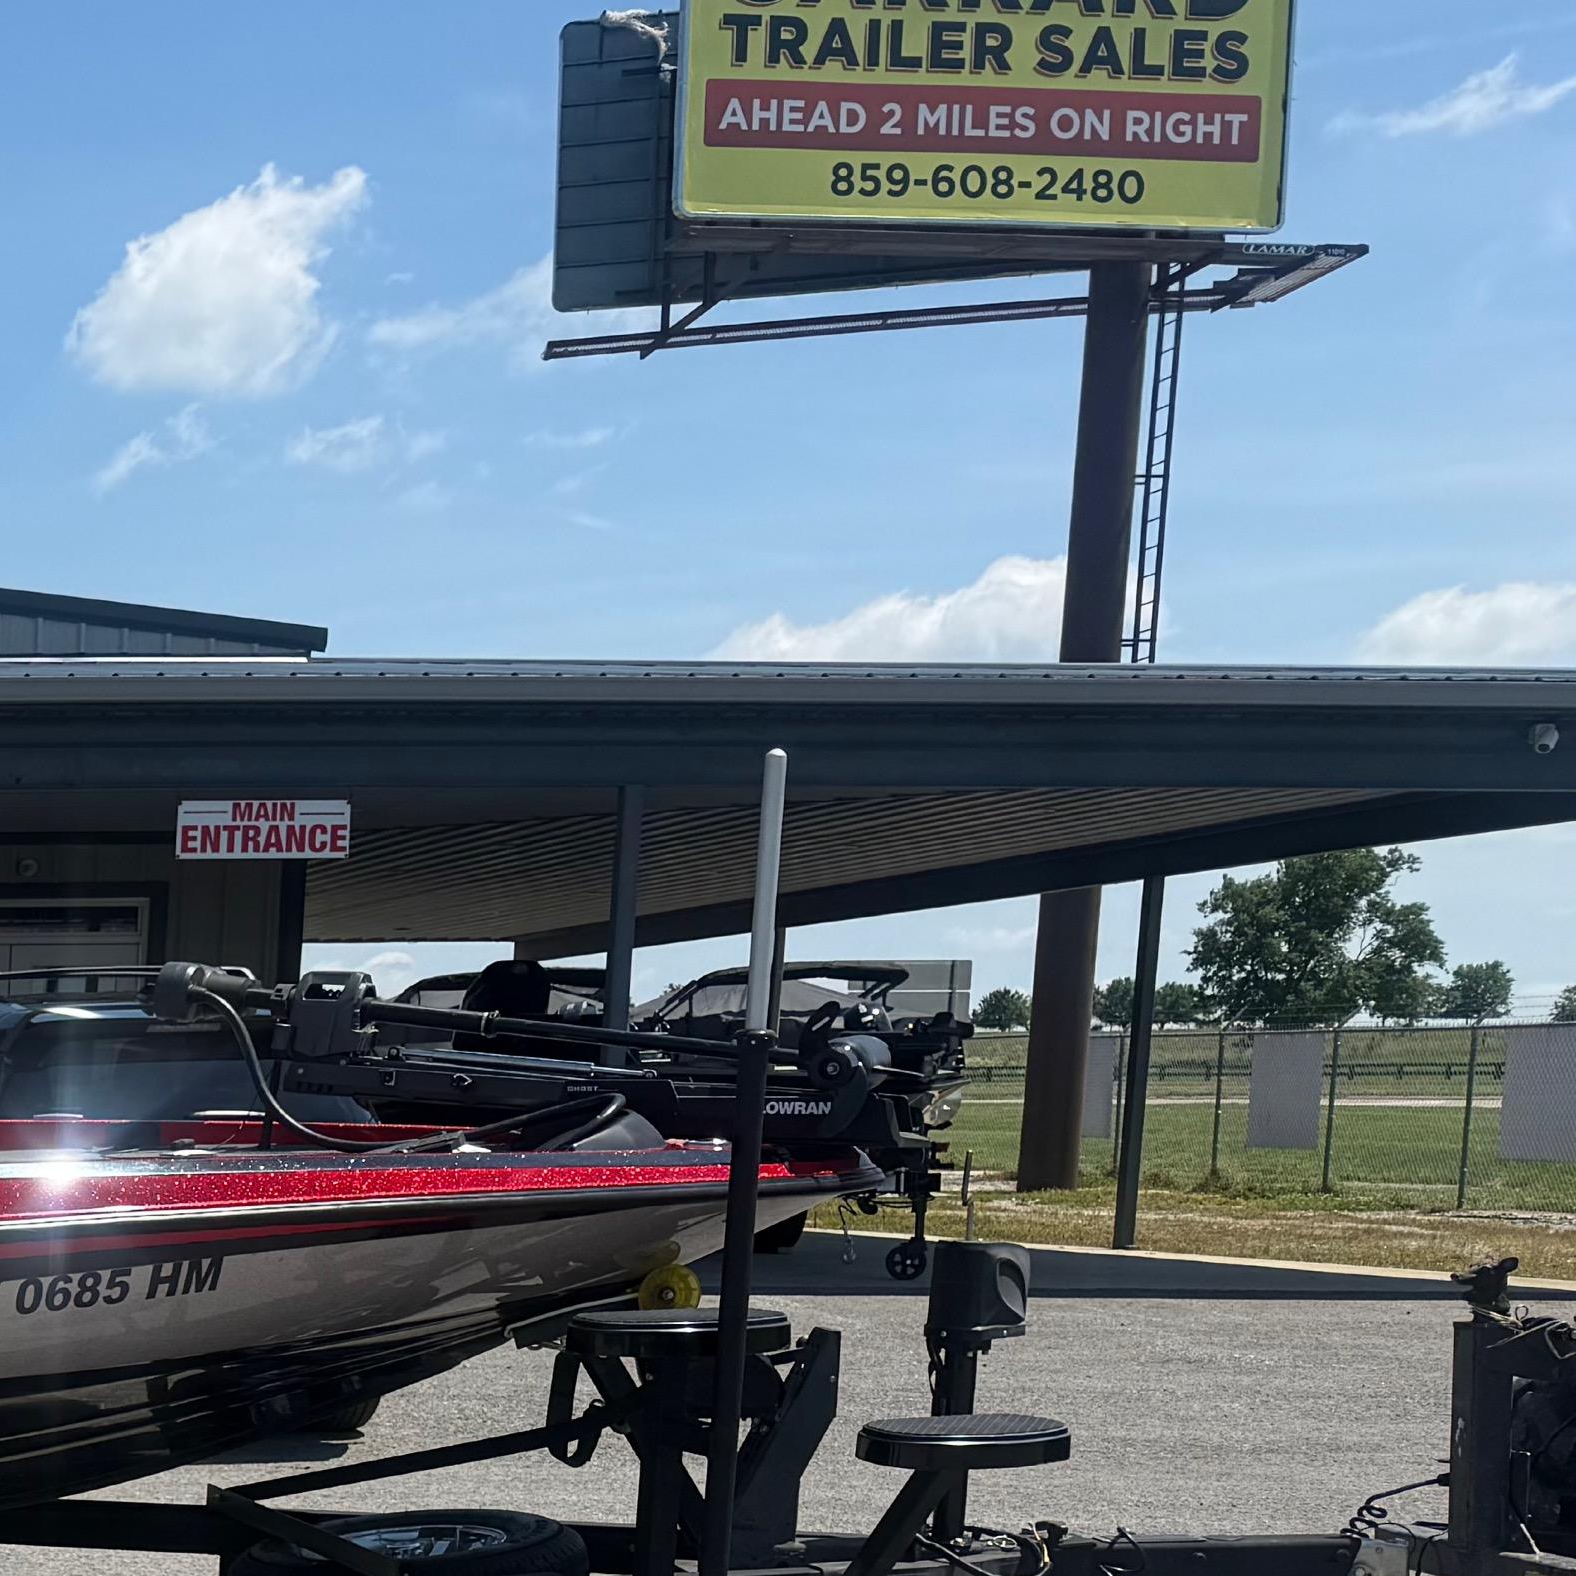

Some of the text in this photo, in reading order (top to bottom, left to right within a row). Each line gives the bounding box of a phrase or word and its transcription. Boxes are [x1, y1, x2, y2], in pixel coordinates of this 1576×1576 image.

[719, 13, 1250, 83] TRAILER SALES
[718, 97, 1248, 145] AHEAD 2 MILES ON RIGHT
[830, 161, 1145, 205] 859-608-2480
[1248, 244, 1307, 256] LAMAR
[231, 801, 296, 822] MAIN
[180, 823, 348, 854] ENTRANCE
[15, 1268, 131, 1315] 0685
[145, 1256, 225, 1300] HM
